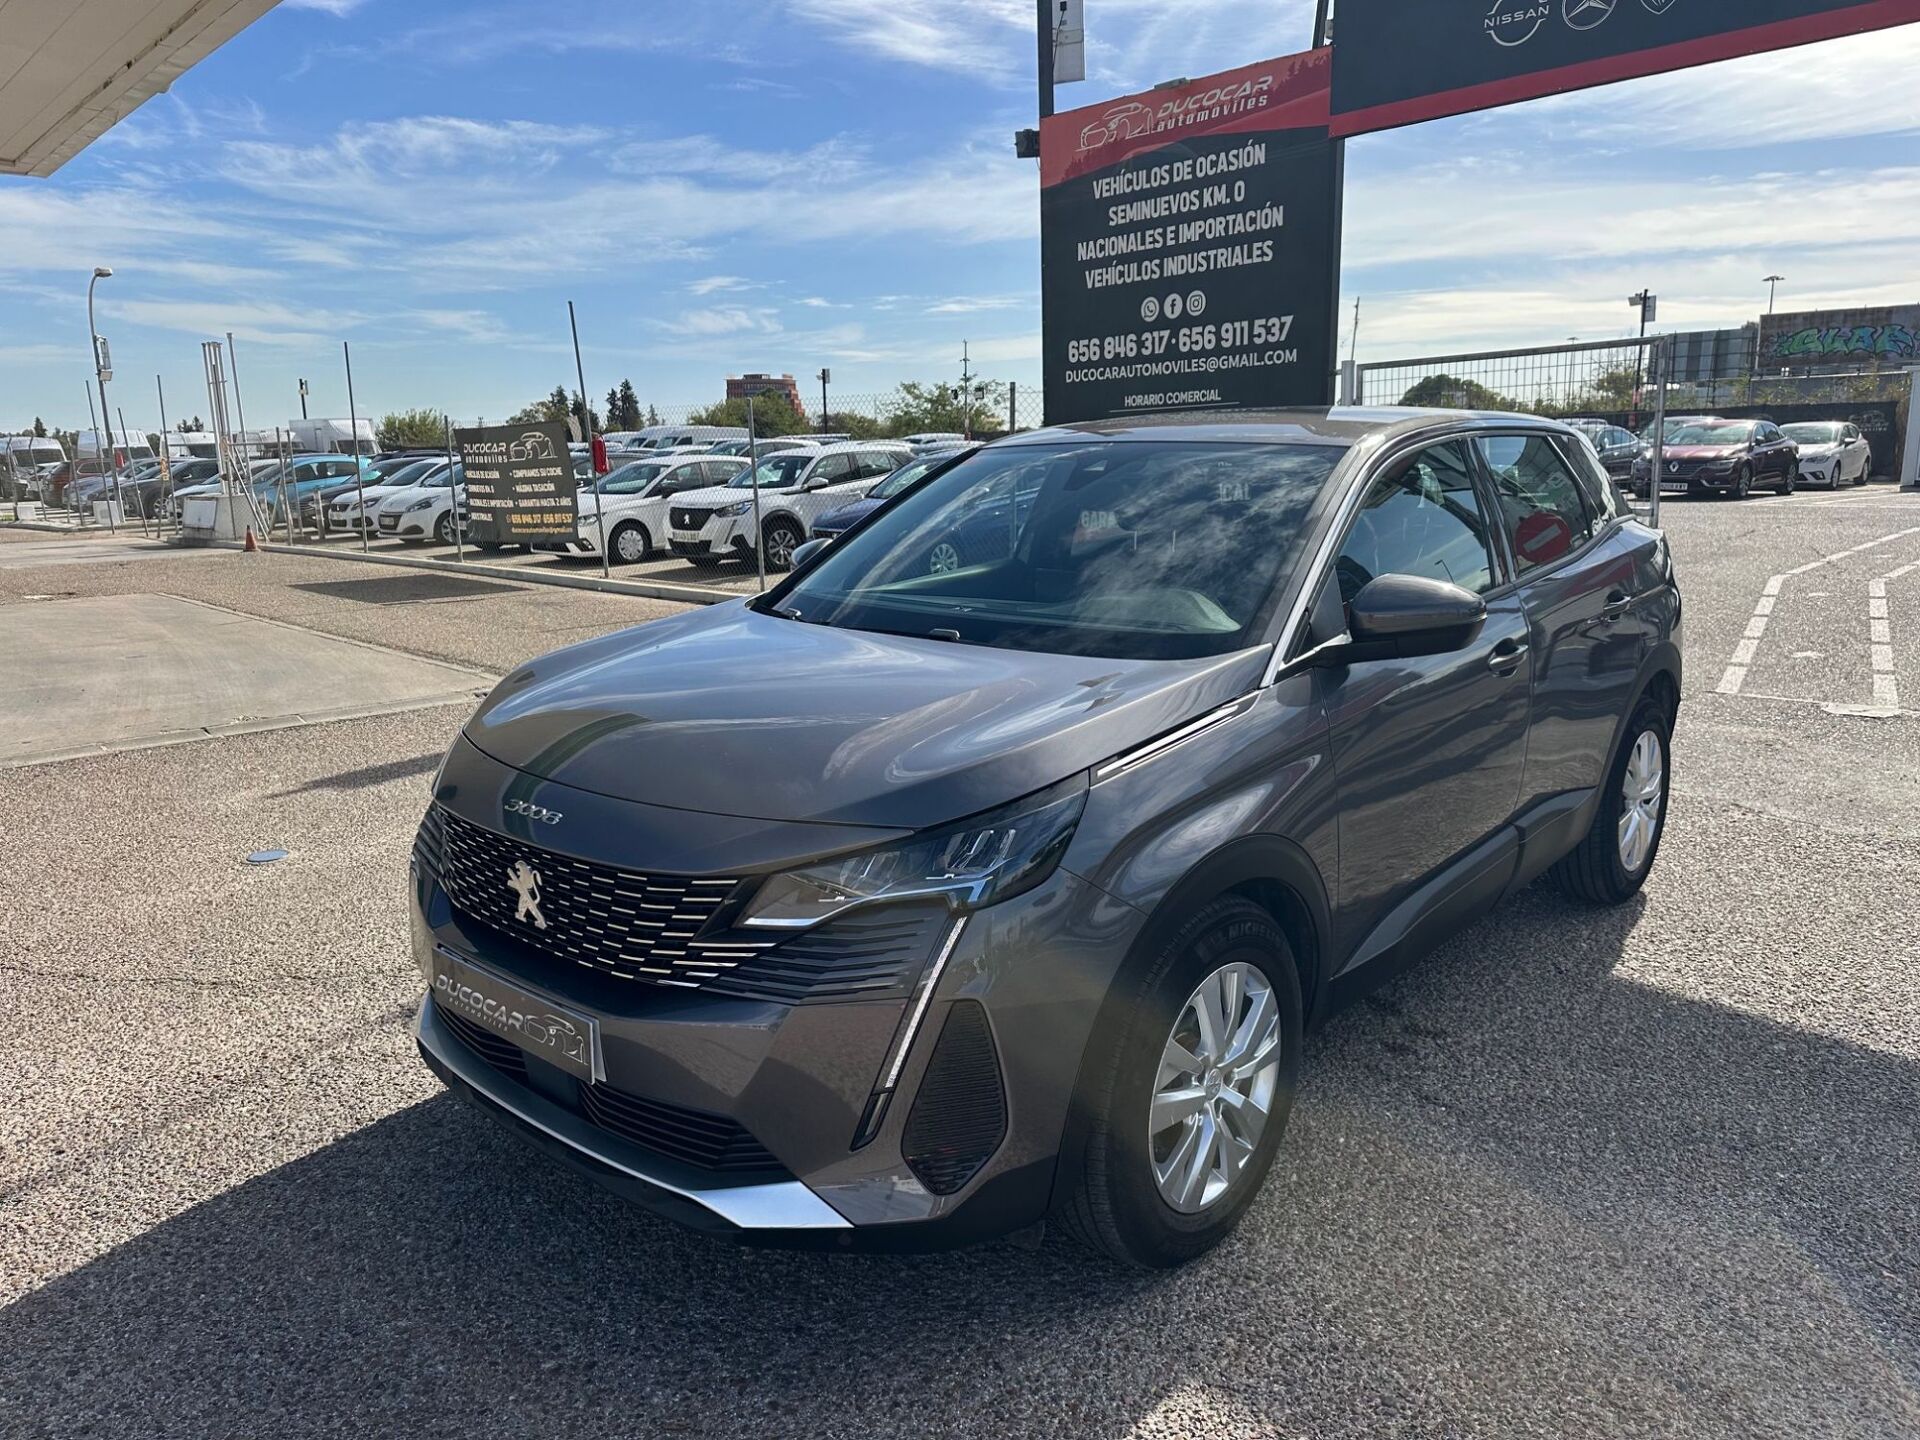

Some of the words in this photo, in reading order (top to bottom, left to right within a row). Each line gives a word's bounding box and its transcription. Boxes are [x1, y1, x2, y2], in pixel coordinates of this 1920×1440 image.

[1484, 5, 1550, 29] NISSAN
[1157, 76, 1272, 118] DUCOCAR
[1157, 94, 1268, 132] automoviles
[1093, 165, 1170, 199] VEHÍCULOS
[1173, 161, 1193, 182] DE
[1196, 139, 1266, 178] OCASIÓN
[1108, 189, 1200, 226] SEMINUEVOS
[1203, 184, 1231, 210] KM.
[1077, 231, 1163, 261] NACIONALES
[1166, 229, 1176, 247] E
[1178, 202, 1284, 244] IMPORTACIÓN
[1085, 259, 1160, 289] VEHÍCULOS
[1163, 240, 1273, 278] INDUSTRIALES
[1068, 337, 1100, 363] 656
[1103, 333, 1137, 360] 846
[1178, 324, 1216, 352] 656
[1220, 320, 1249, 348] 911
[1253, 315, 1294, 345] 537
[1065, 348, 1298, 383] DUCOCARAUTOMOVILES@GMAIL.COM
[1124, 393, 1164, 407] HORARIO
[1166, 388, 1221, 405] COMERCIAL
[463, 442, 506, 454] DUCOCAR
[504, 799, 563, 825] 3008
[436, 974, 524, 1030] DUCOCAR
